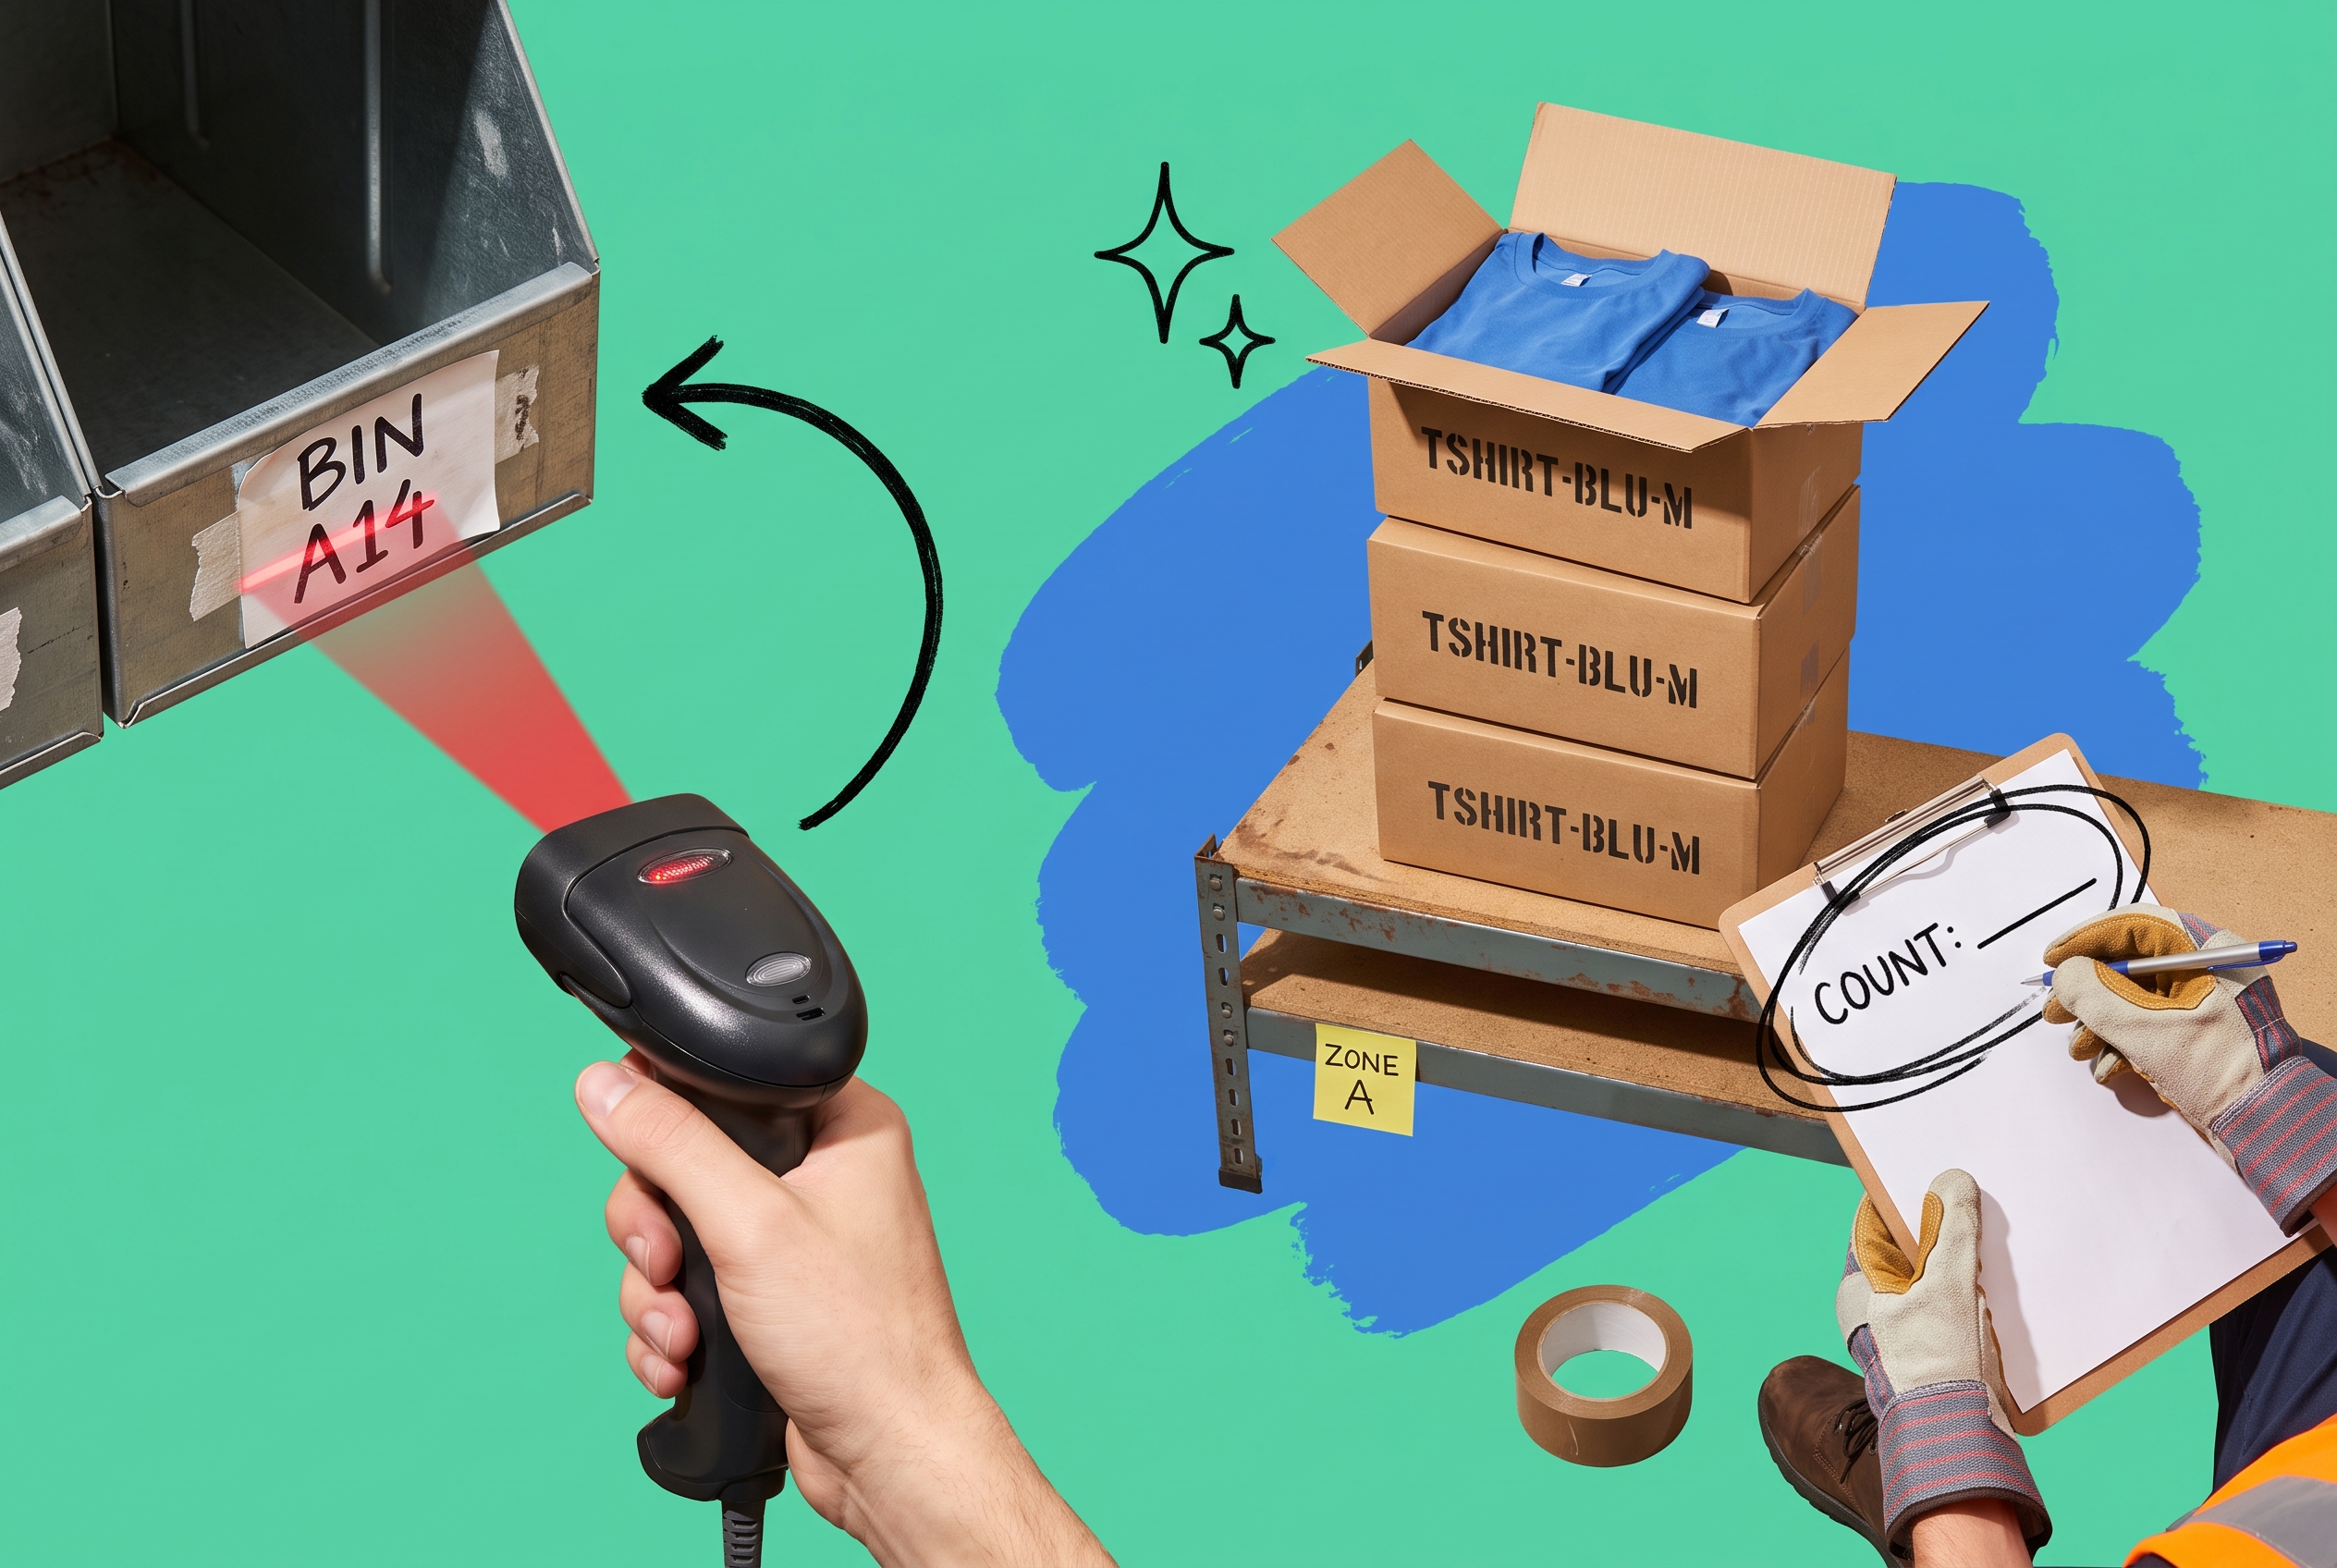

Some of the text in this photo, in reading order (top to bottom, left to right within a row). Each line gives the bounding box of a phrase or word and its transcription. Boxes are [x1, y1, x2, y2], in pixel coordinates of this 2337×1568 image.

[297, 392, 423, 511] BIN
[1421, 425, 1693, 530] TSHIRT-BLU-M
[293, 479, 435, 606] A14
[1422, 610, 1698, 709] TSHIRT-BLU-M
[1427, 780, 1701, 876] TSHIRT-BLU-M
[1814, 922, 1963, 1025] COUNT:
[1325, 1043, 1400, 1077] ZONE
[1344, 1079, 1375, 1115] A
